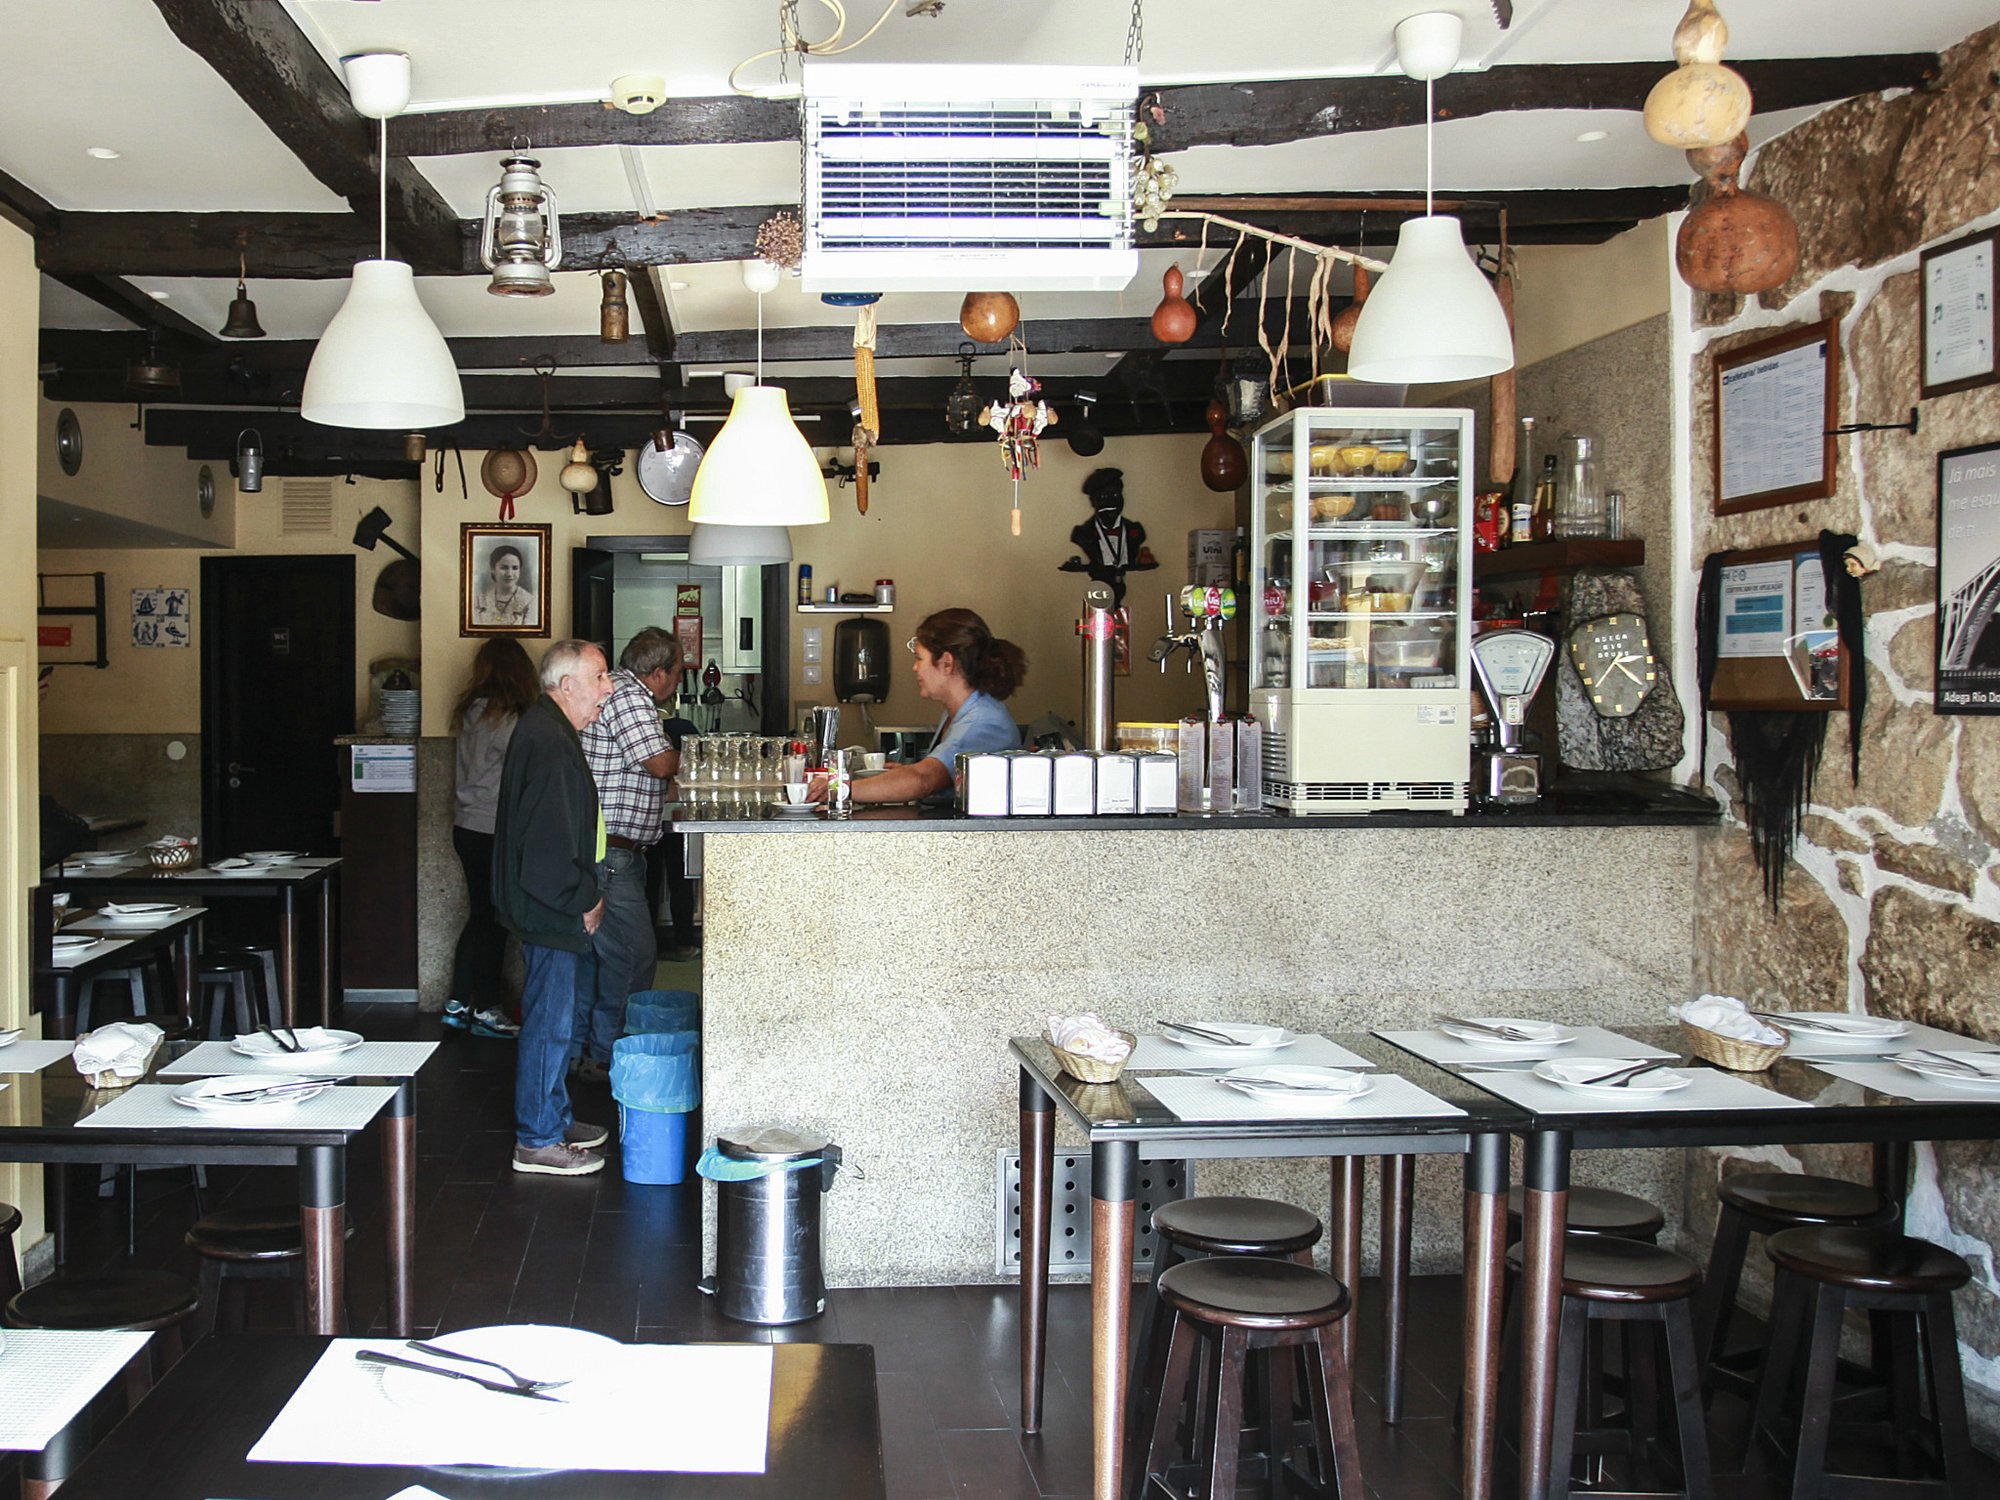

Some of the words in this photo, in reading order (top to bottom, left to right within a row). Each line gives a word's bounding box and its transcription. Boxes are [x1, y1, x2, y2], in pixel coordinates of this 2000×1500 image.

[1965, 462, 1997, 480] mais
[1943, 691, 1970, 705] Adega
[1972, 691, 1987, 703] Rio
